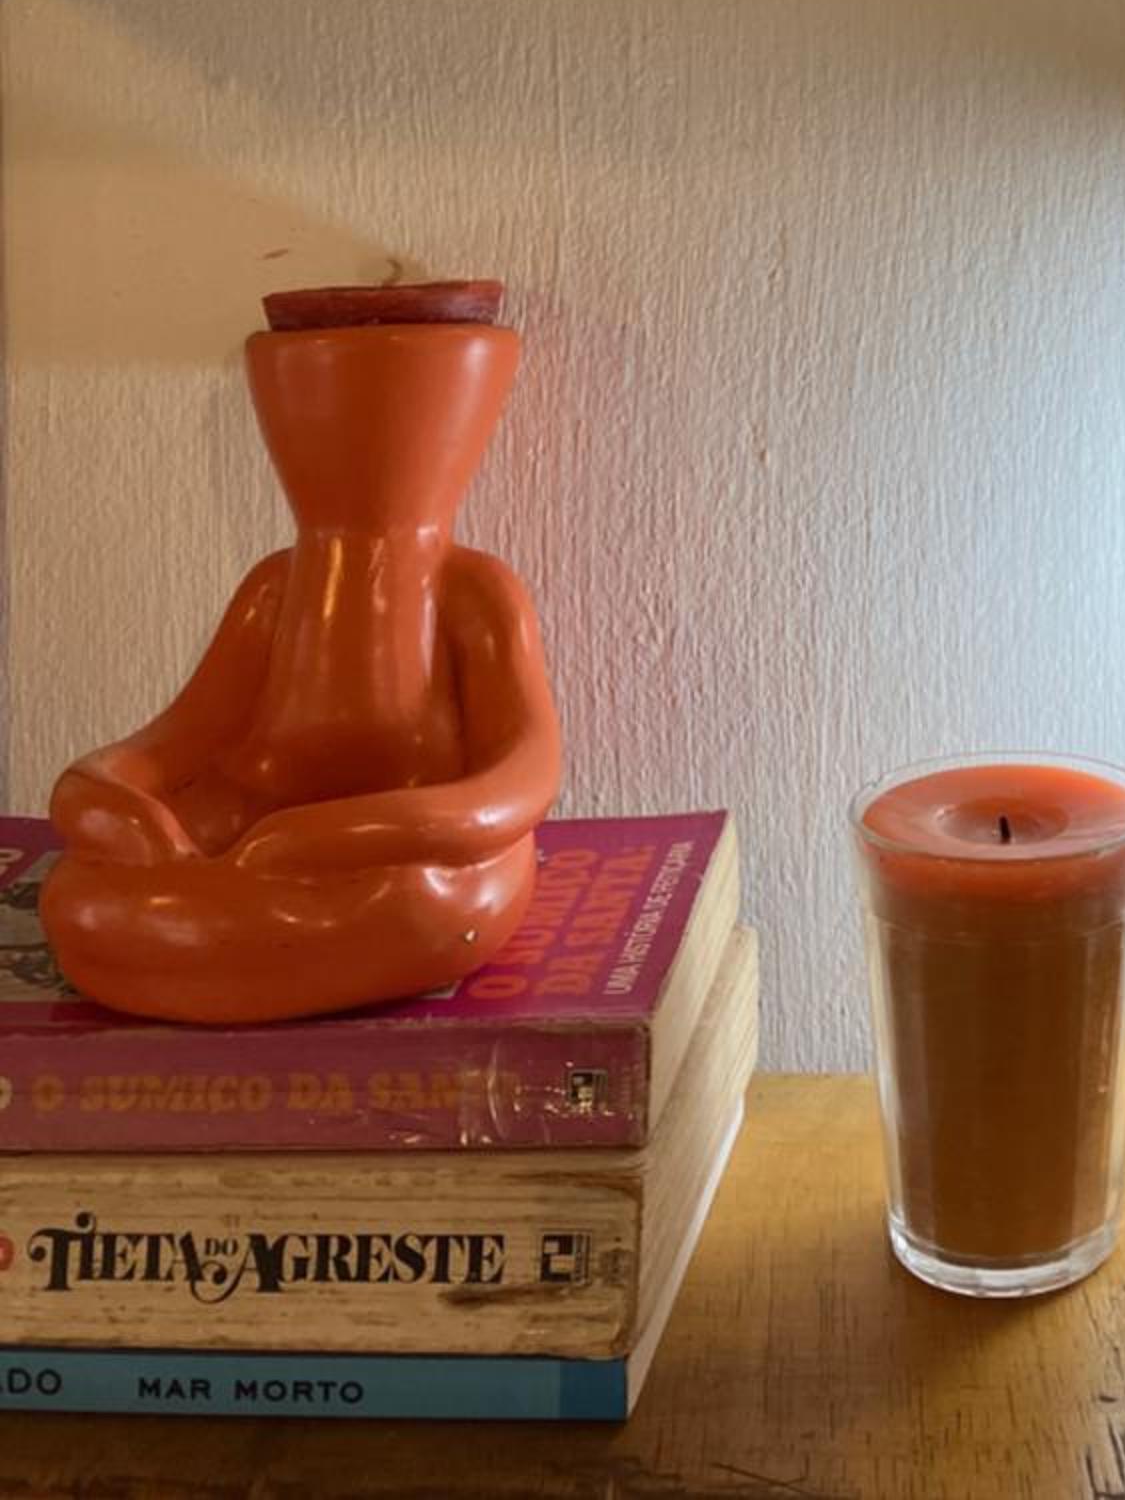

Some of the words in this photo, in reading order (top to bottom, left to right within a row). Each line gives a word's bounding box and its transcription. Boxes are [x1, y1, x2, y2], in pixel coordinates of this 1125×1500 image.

[467, 974, 529, 1000] O
[532, 951, 606, 997] DA
[602, 963, 642, 996] UMA
[32, 1075, 65, 1113] O
[287, 1072, 353, 1111] DA
[27, 1211, 207, 1298] TIETA
[204, 1237, 238, 1257] DO
[240, 1231, 506, 1293] AGRESTE
[0, 1366, 63, 1396] DO
[138, 1377, 212, 1401] MAR
[234, 1380, 364, 1404] MORTO
